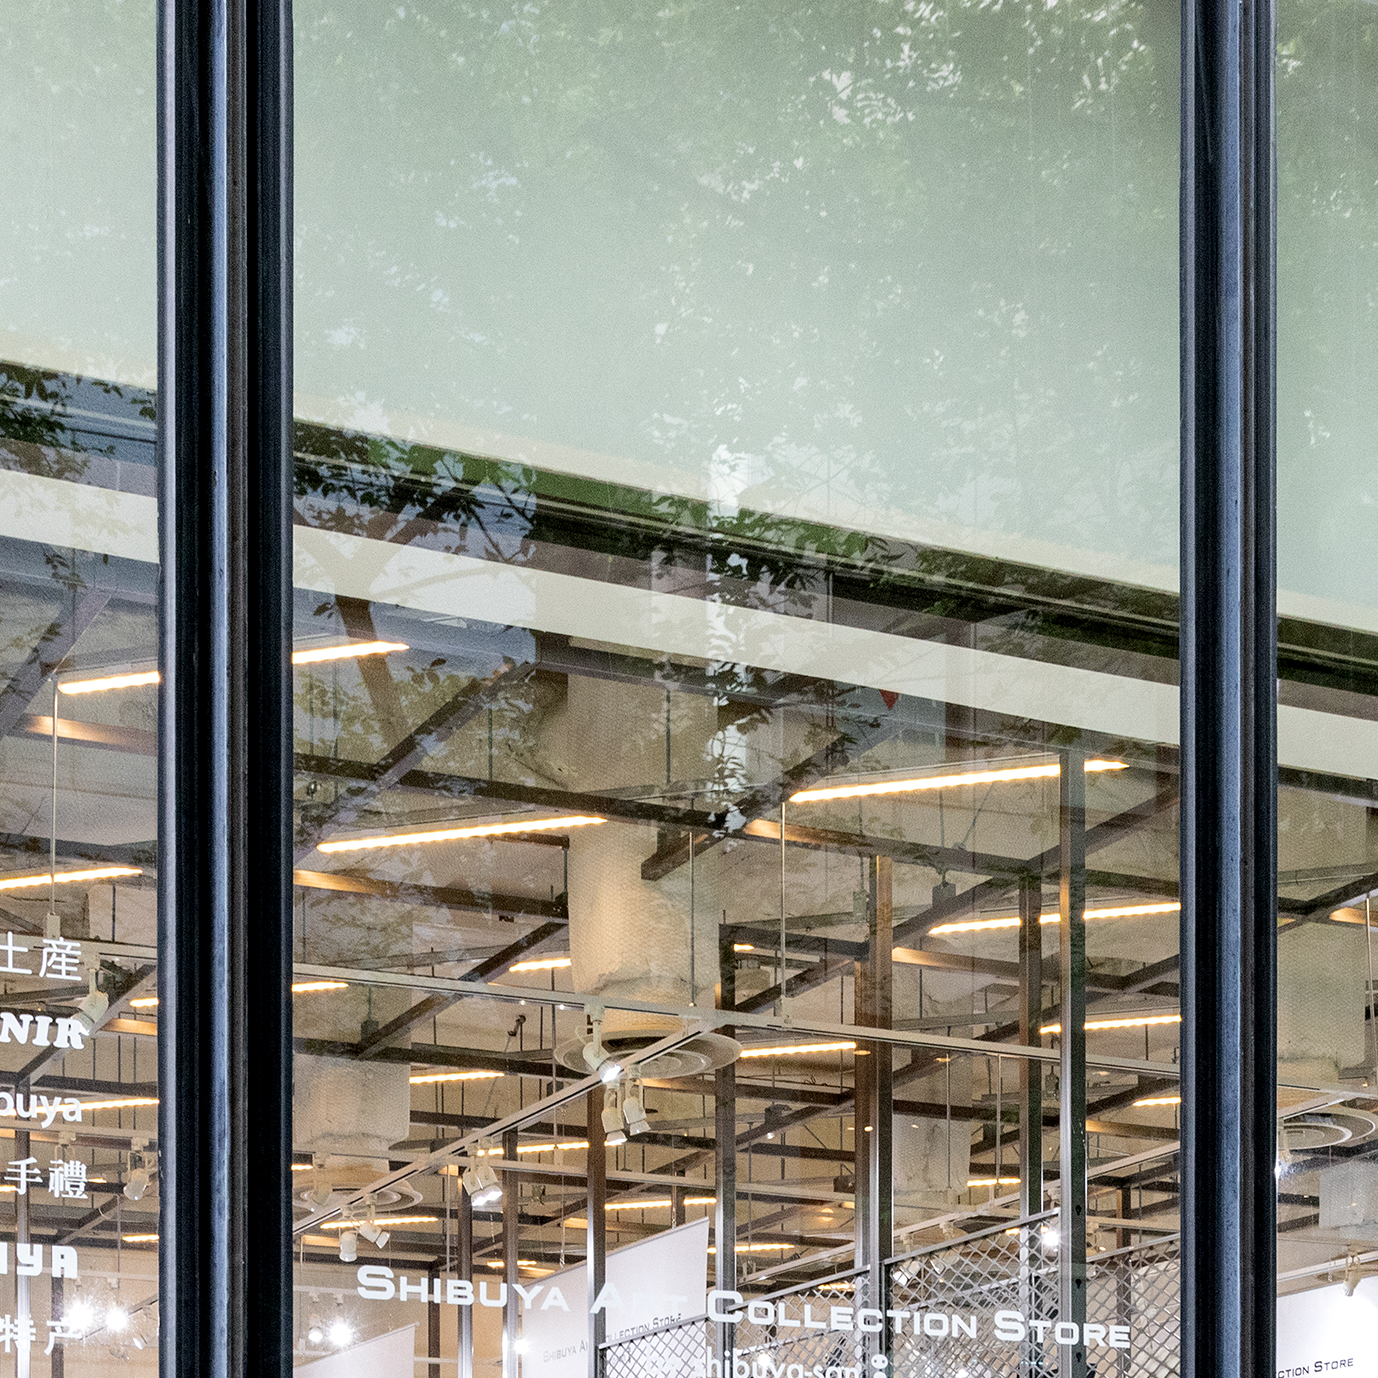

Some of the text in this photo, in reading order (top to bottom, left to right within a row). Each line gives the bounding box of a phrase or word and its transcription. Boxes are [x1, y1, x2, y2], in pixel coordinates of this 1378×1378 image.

[356, 1264, 571, 1314] SHIBUYA
[707, 1289, 978, 1339] COLLECTION
[994, 1308, 1131, 1349] STORE
[1313, 1358, 1354, 1373] STORE
